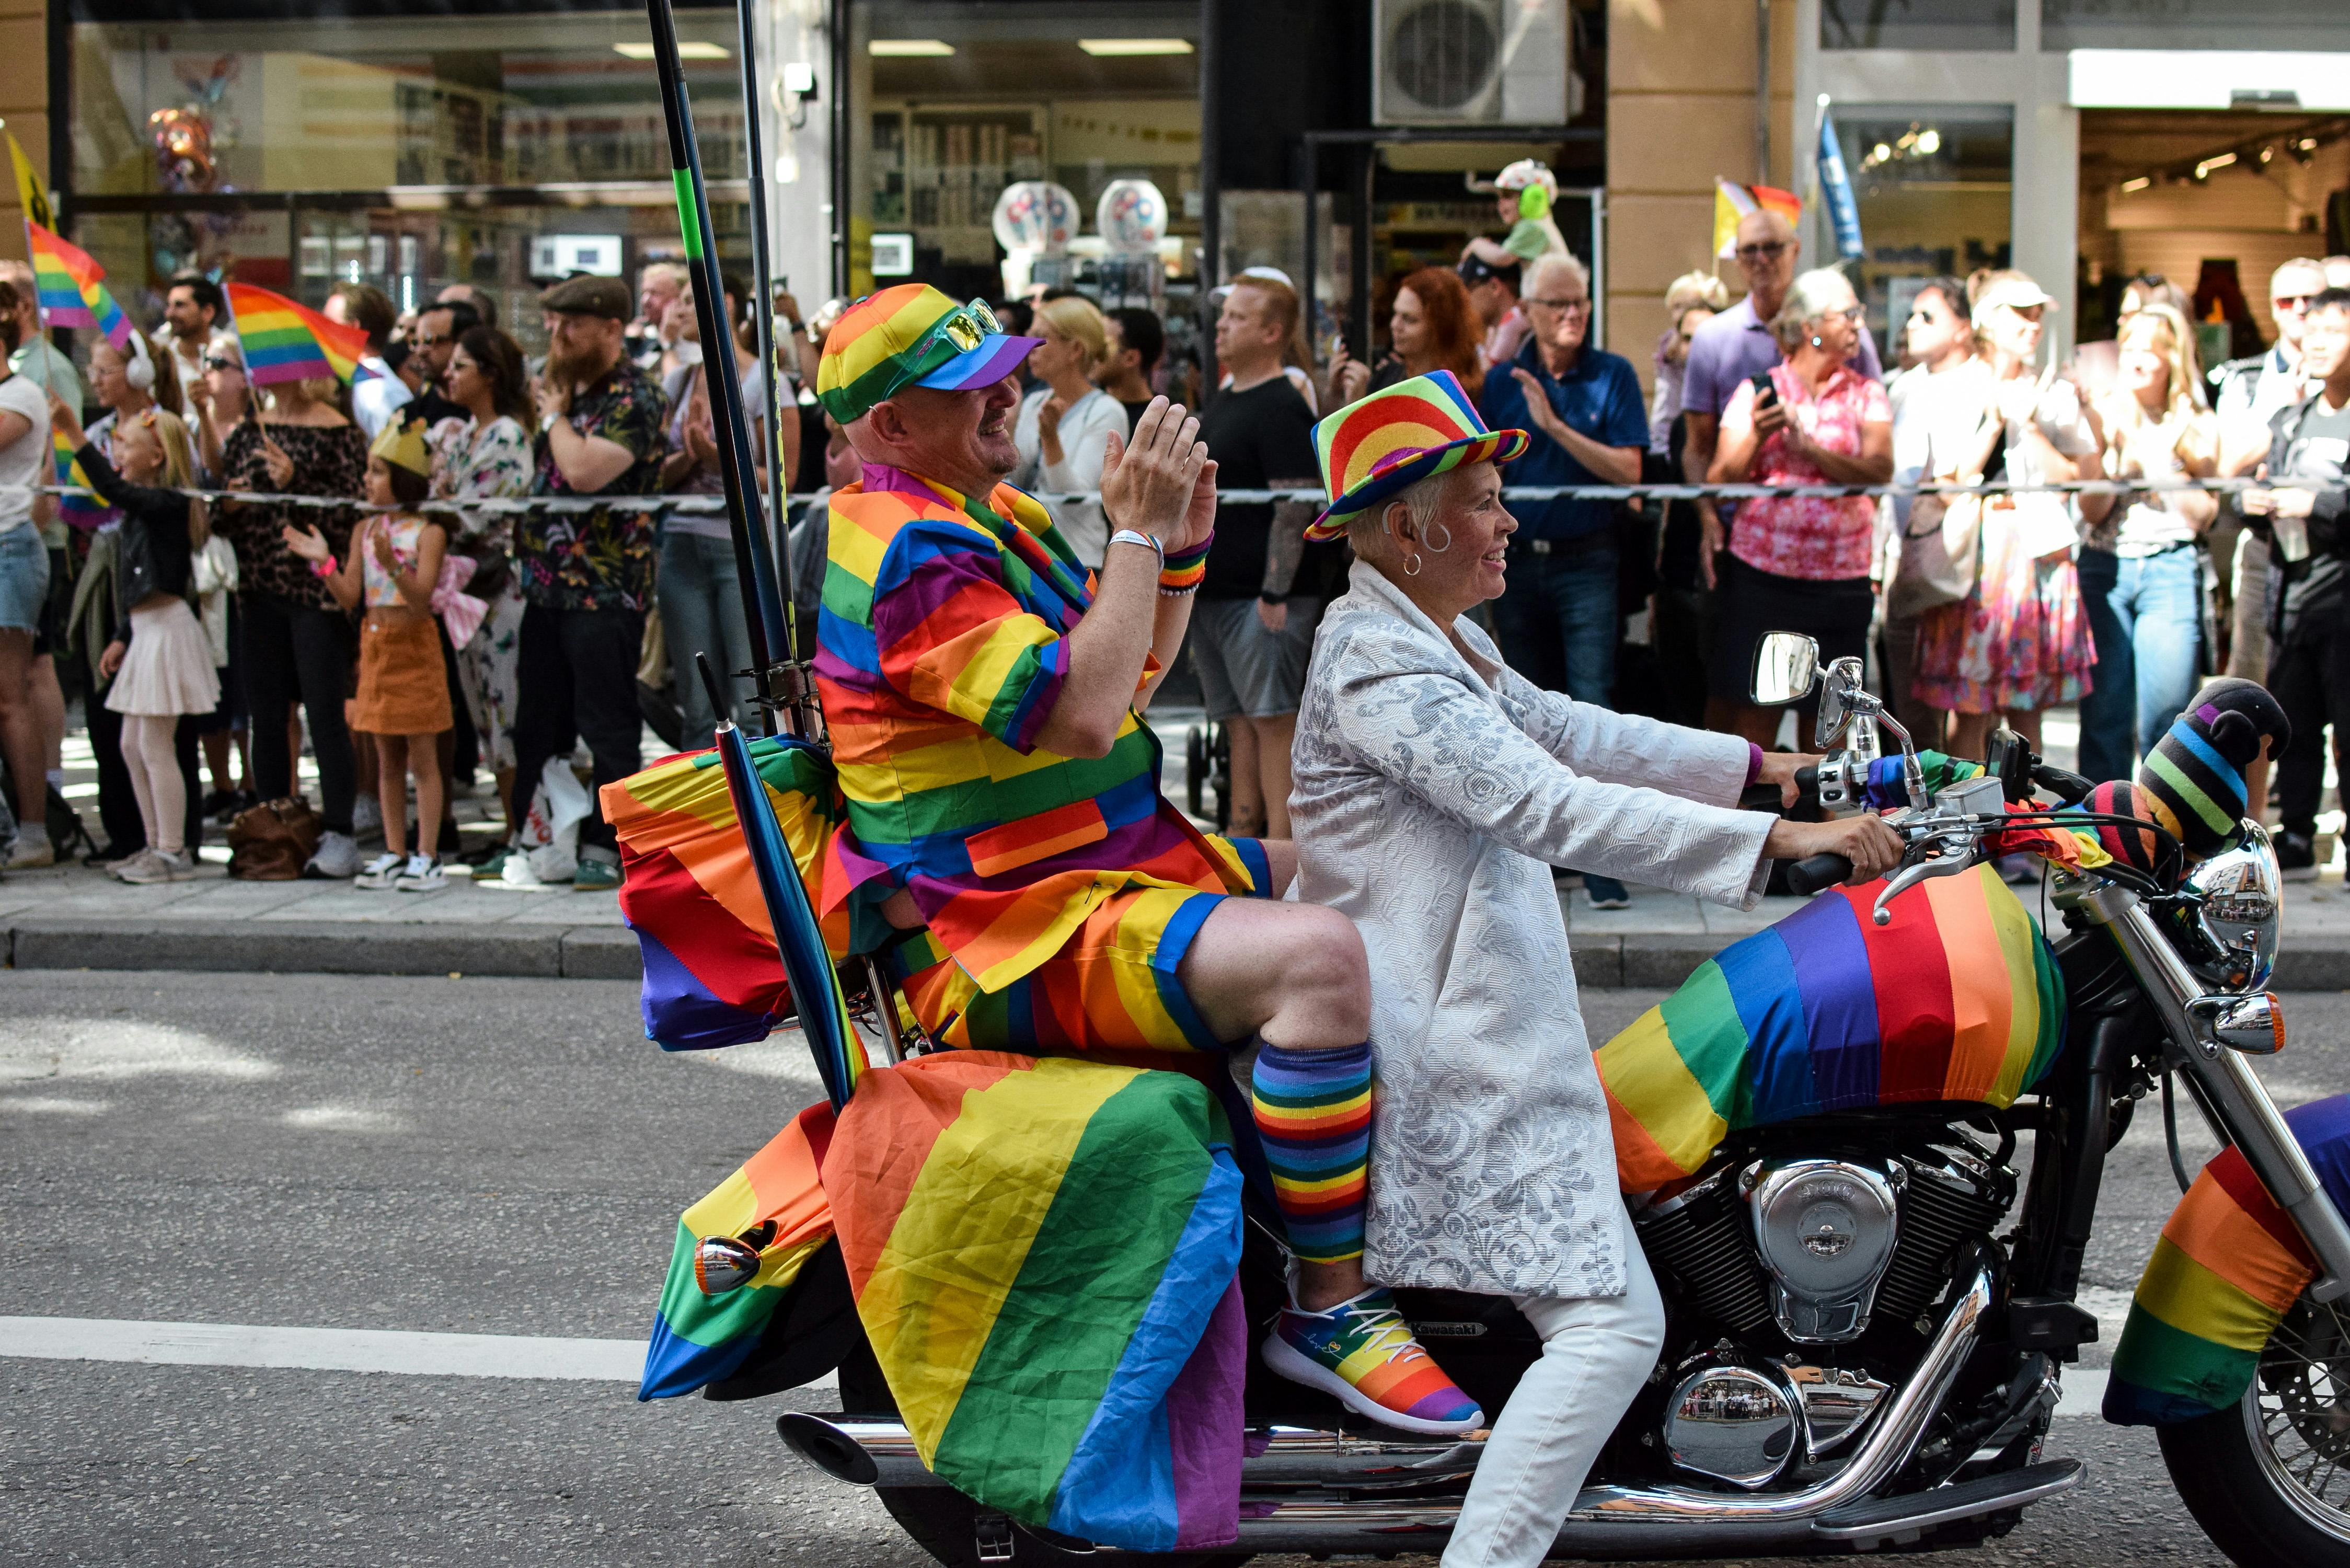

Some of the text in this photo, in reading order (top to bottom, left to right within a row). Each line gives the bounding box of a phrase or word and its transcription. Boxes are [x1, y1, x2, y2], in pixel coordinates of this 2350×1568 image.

[1798, 1180, 1855, 1201] 900
[1412, 1323, 1476, 1334] Kawasaki
[1308, 1333, 1329, 1353] love
